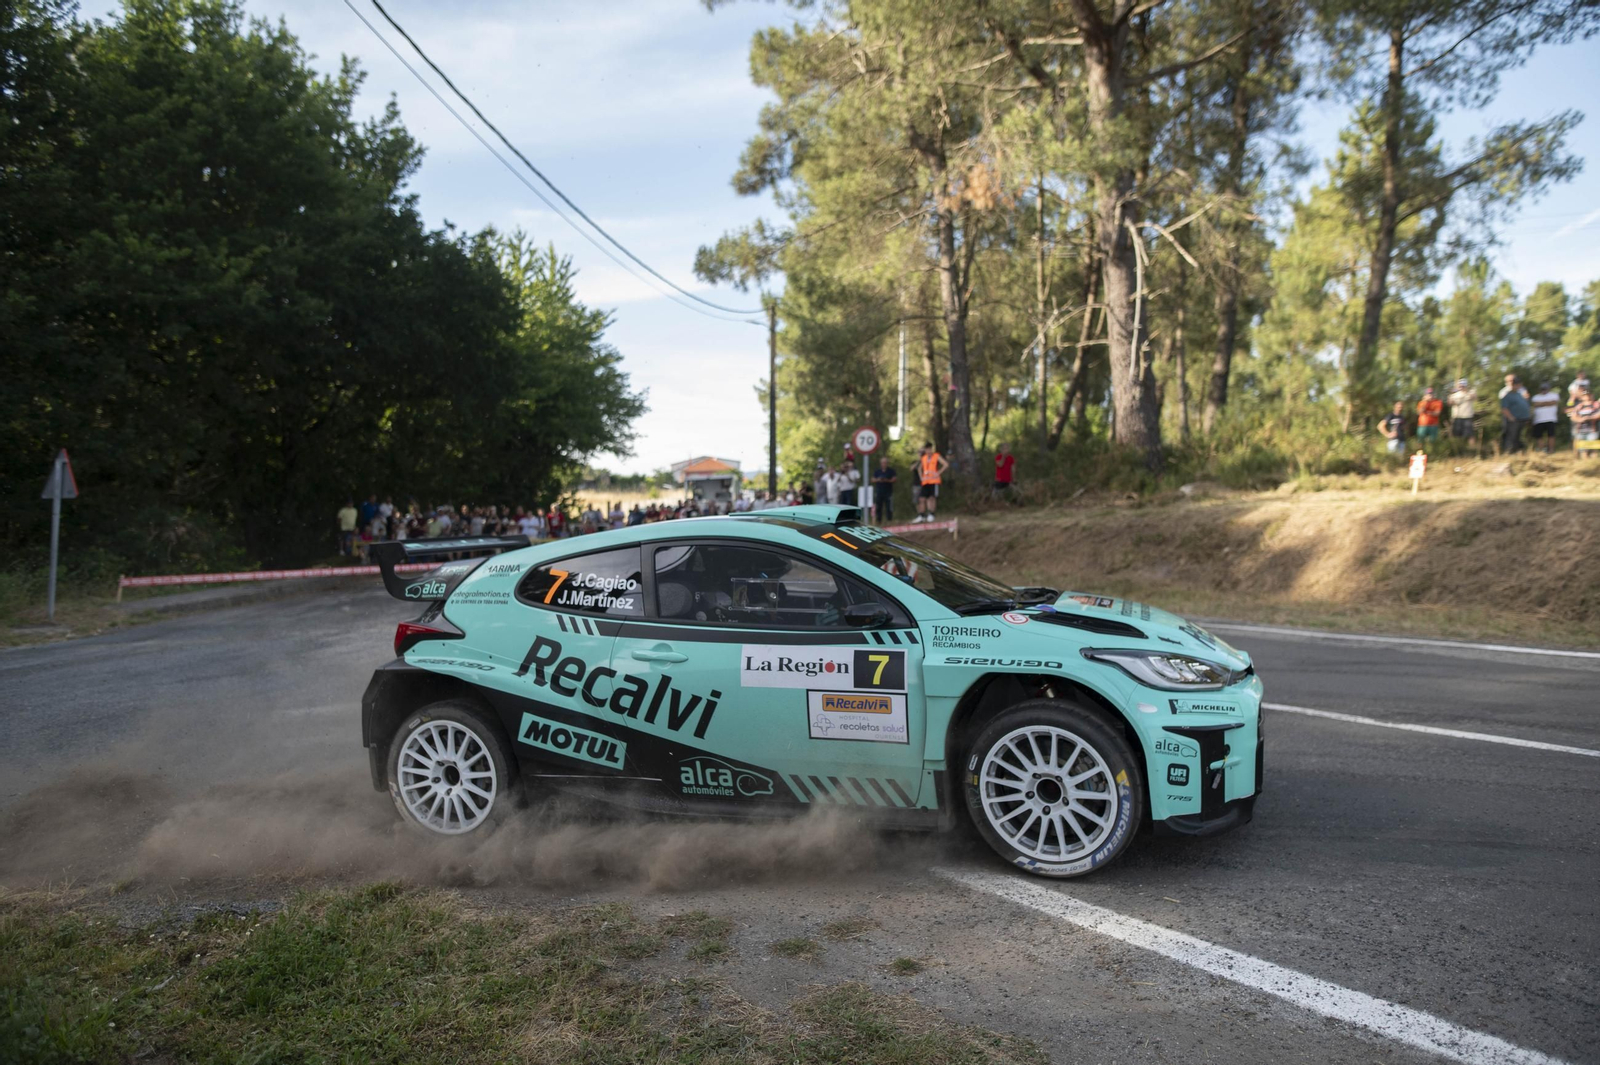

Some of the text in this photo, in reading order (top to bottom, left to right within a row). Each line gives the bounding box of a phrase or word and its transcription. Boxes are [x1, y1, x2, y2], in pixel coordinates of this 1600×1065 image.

[859, 436, 875, 446] 70
[821, 532, 858, 550] 7
[422, 581, 447, 594] alca
[543, 569, 569, 604] 7
[572, 573, 637, 592] J.Cagiao
[454, 590, 511, 599] integralmotion.es
[557, 590, 634, 609] J.Martínez
[932, 625, 1002, 638] TORREIRO
[932, 641, 981, 650] RECAMBIOS
[745, 656, 772, 671] La
[868, 654, 890, 686] 7
[511, 635, 723, 740] Recalvi
[836, 698, 878, 711] Recalvi
[1191, 704, 1236, 712] MICHELIN
[839, 722, 905, 733] recoletas salud
[523, 720, 620, 764] MOTUL
[1155, 739, 1180, 753] alca
[680, 760, 733, 787] alca
[1170, 768, 1187, 777] UFI
[682, 786, 735, 796] automóviles
[1096, 799, 1130, 862] MICHELIN
